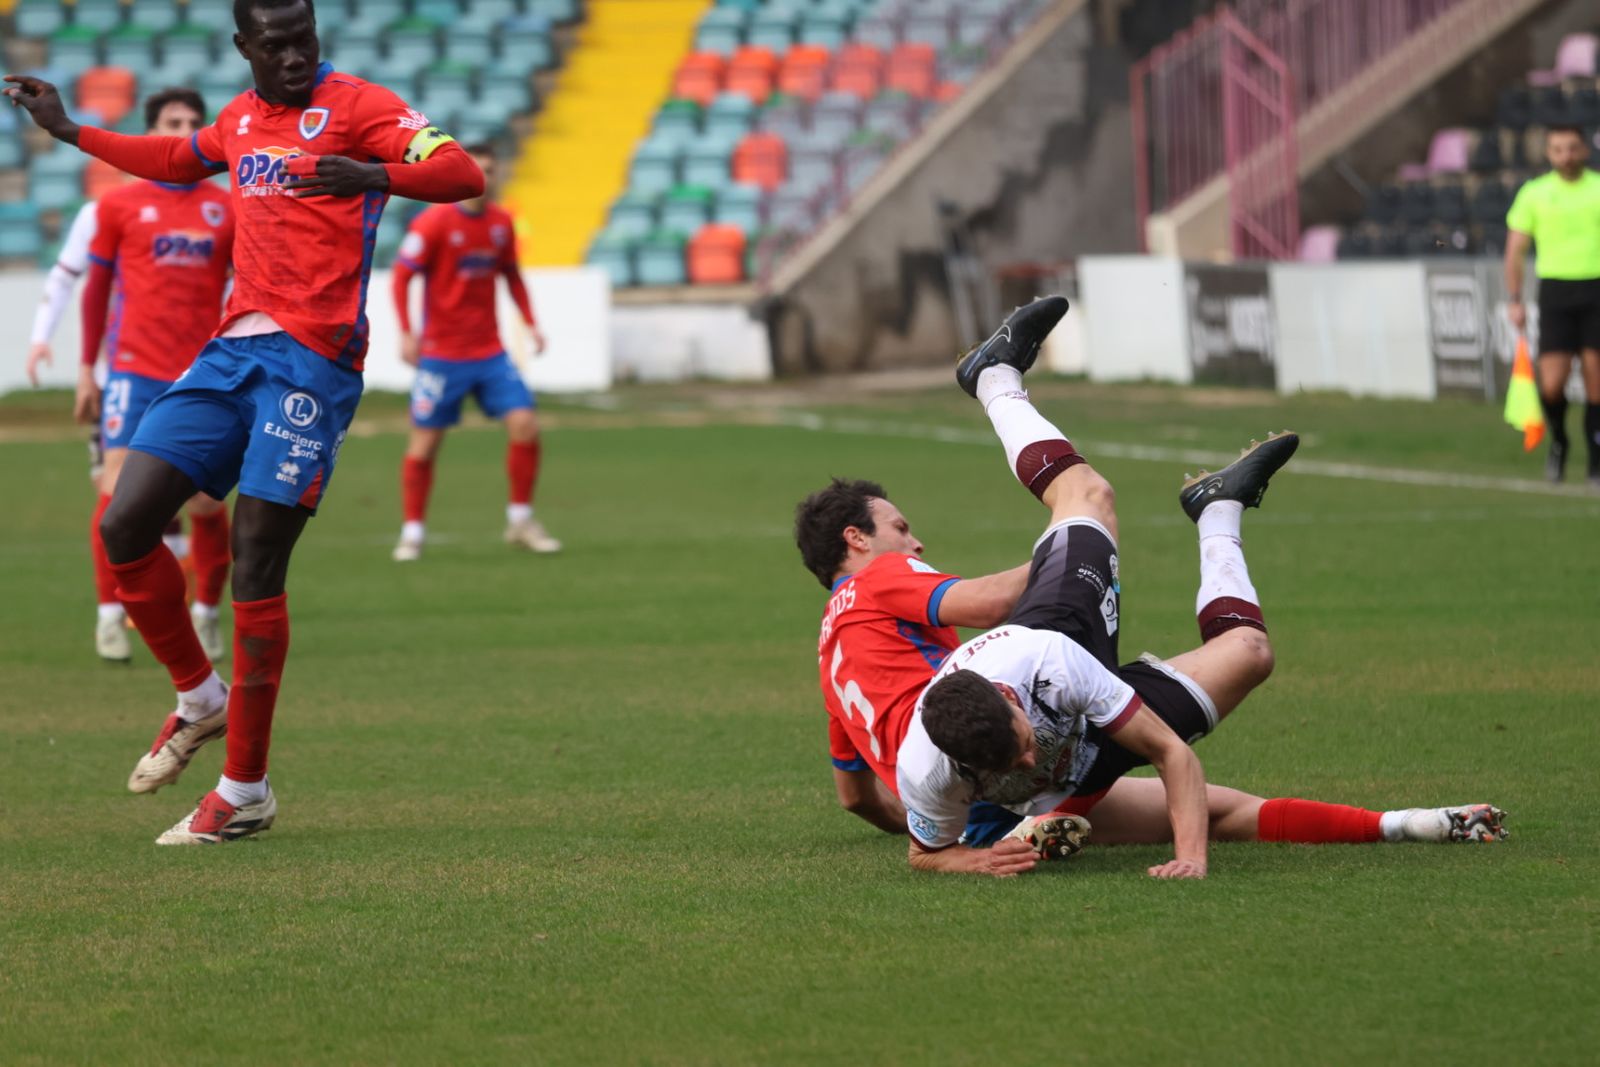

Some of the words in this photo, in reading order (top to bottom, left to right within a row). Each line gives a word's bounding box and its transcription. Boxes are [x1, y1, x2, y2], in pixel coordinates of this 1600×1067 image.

[264, 422, 322, 450] E.Leclerc
[288, 444, 319, 460] Soria
[831, 640, 881, 762] 5
